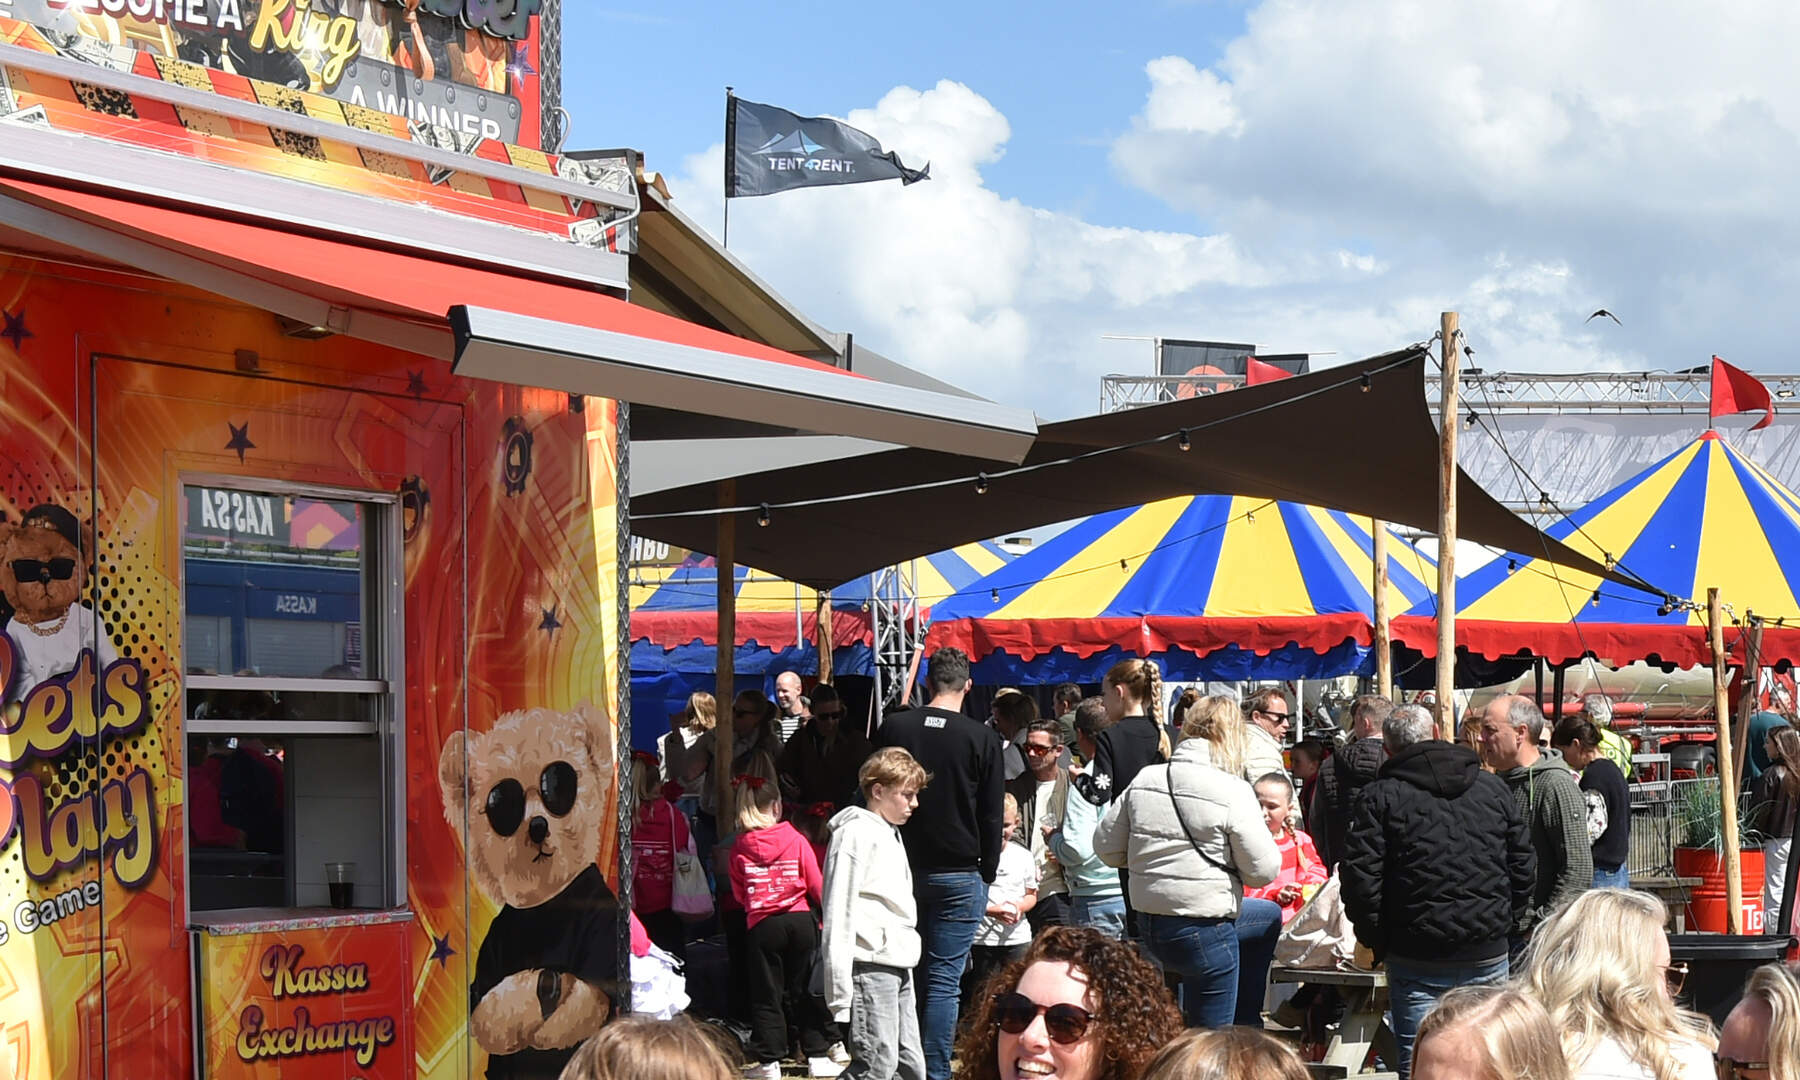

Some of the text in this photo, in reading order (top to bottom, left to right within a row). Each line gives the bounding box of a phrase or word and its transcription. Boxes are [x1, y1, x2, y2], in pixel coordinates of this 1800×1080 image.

[216, 0, 243, 32] A
[250, 0, 359, 83] King
[377, 91, 501, 140] WINNER
[14, 880, 101, 935] Game
[261, 945, 368, 996] Kassa
[237, 1005, 394, 1066] Exchange
